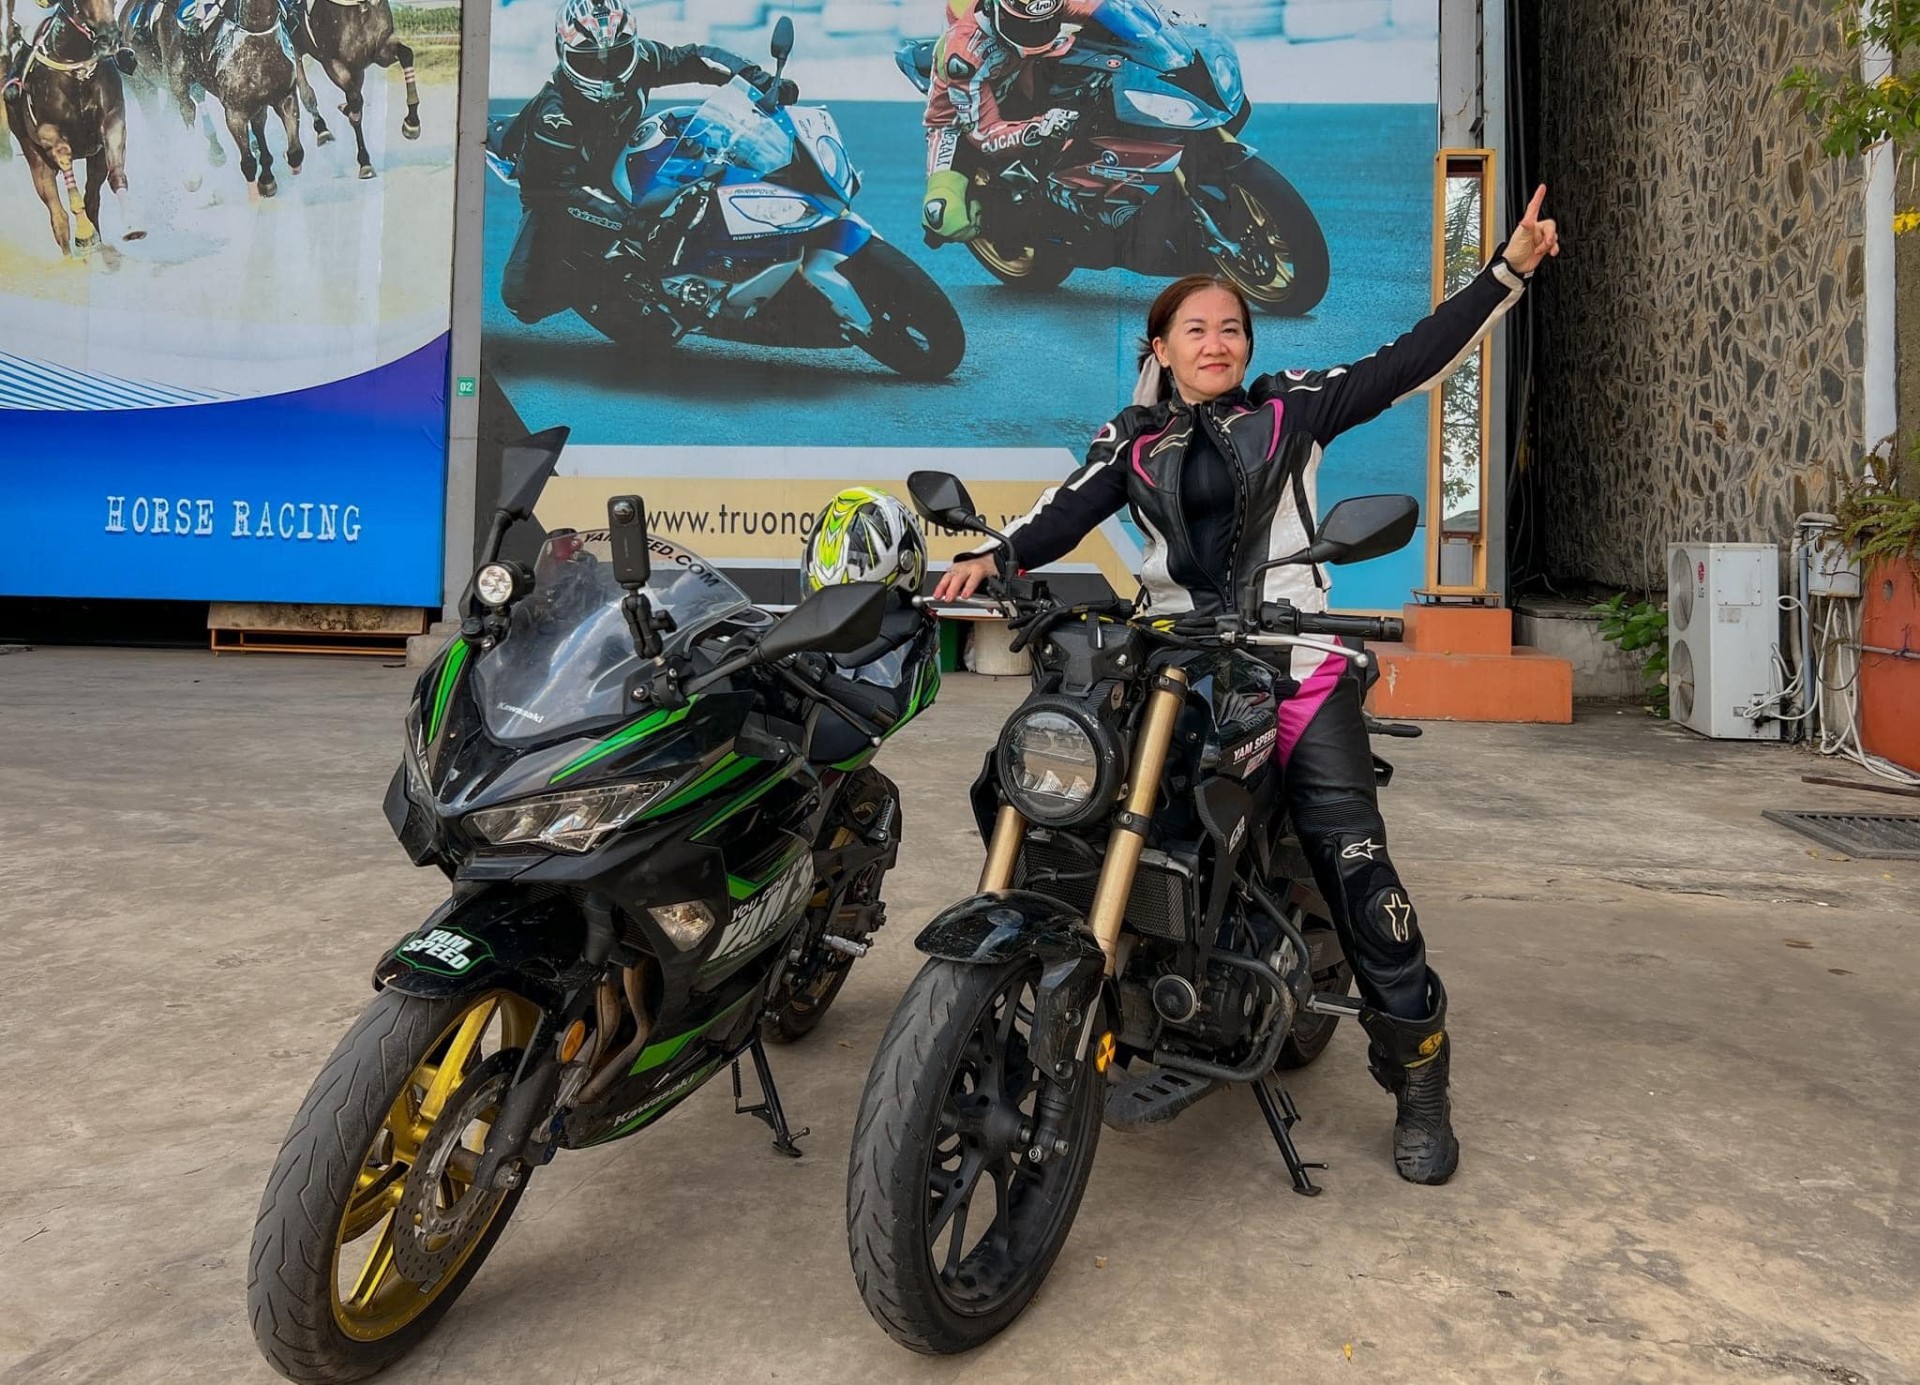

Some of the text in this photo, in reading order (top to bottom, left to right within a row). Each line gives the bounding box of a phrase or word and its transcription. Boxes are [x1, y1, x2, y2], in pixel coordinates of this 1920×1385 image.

[460, 382, 473, 392] 02
[104, 496, 362, 541] HORSE RACING
[496, 702, 544, 724] Kawasaki
[1233, 741, 1254, 761] YAM
[1254, 728, 1277, 750] SPEED
[402, 939, 471, 970] SPEED
[424, 929, 473, 952] YAM
[613, 1072, 696, 1127] Kawasaki
